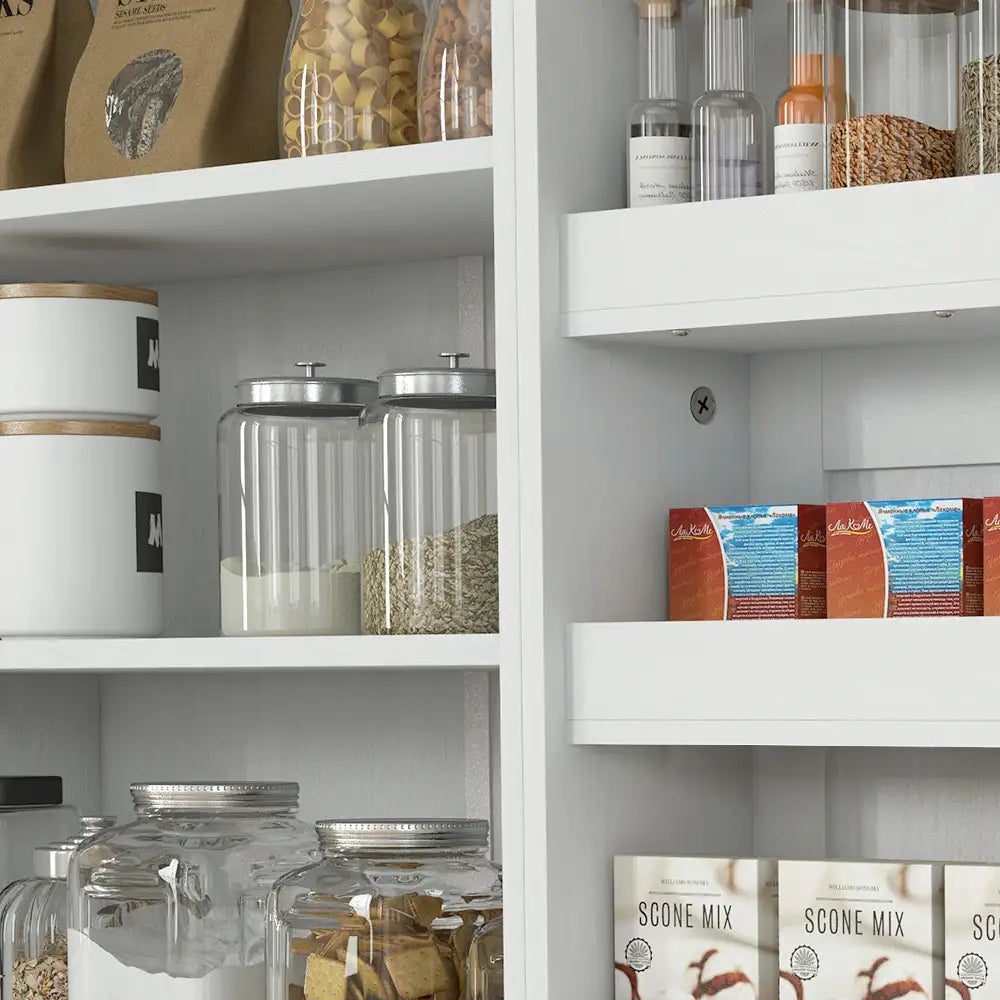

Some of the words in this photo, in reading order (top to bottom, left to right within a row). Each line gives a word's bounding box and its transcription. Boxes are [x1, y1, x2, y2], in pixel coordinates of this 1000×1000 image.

[638, 901, 694, 928] SCONE
[702, 904, 732, 930] MIX
[804, 907, 863, 936] SCONE
[872, 910, 905, 937] MIX
